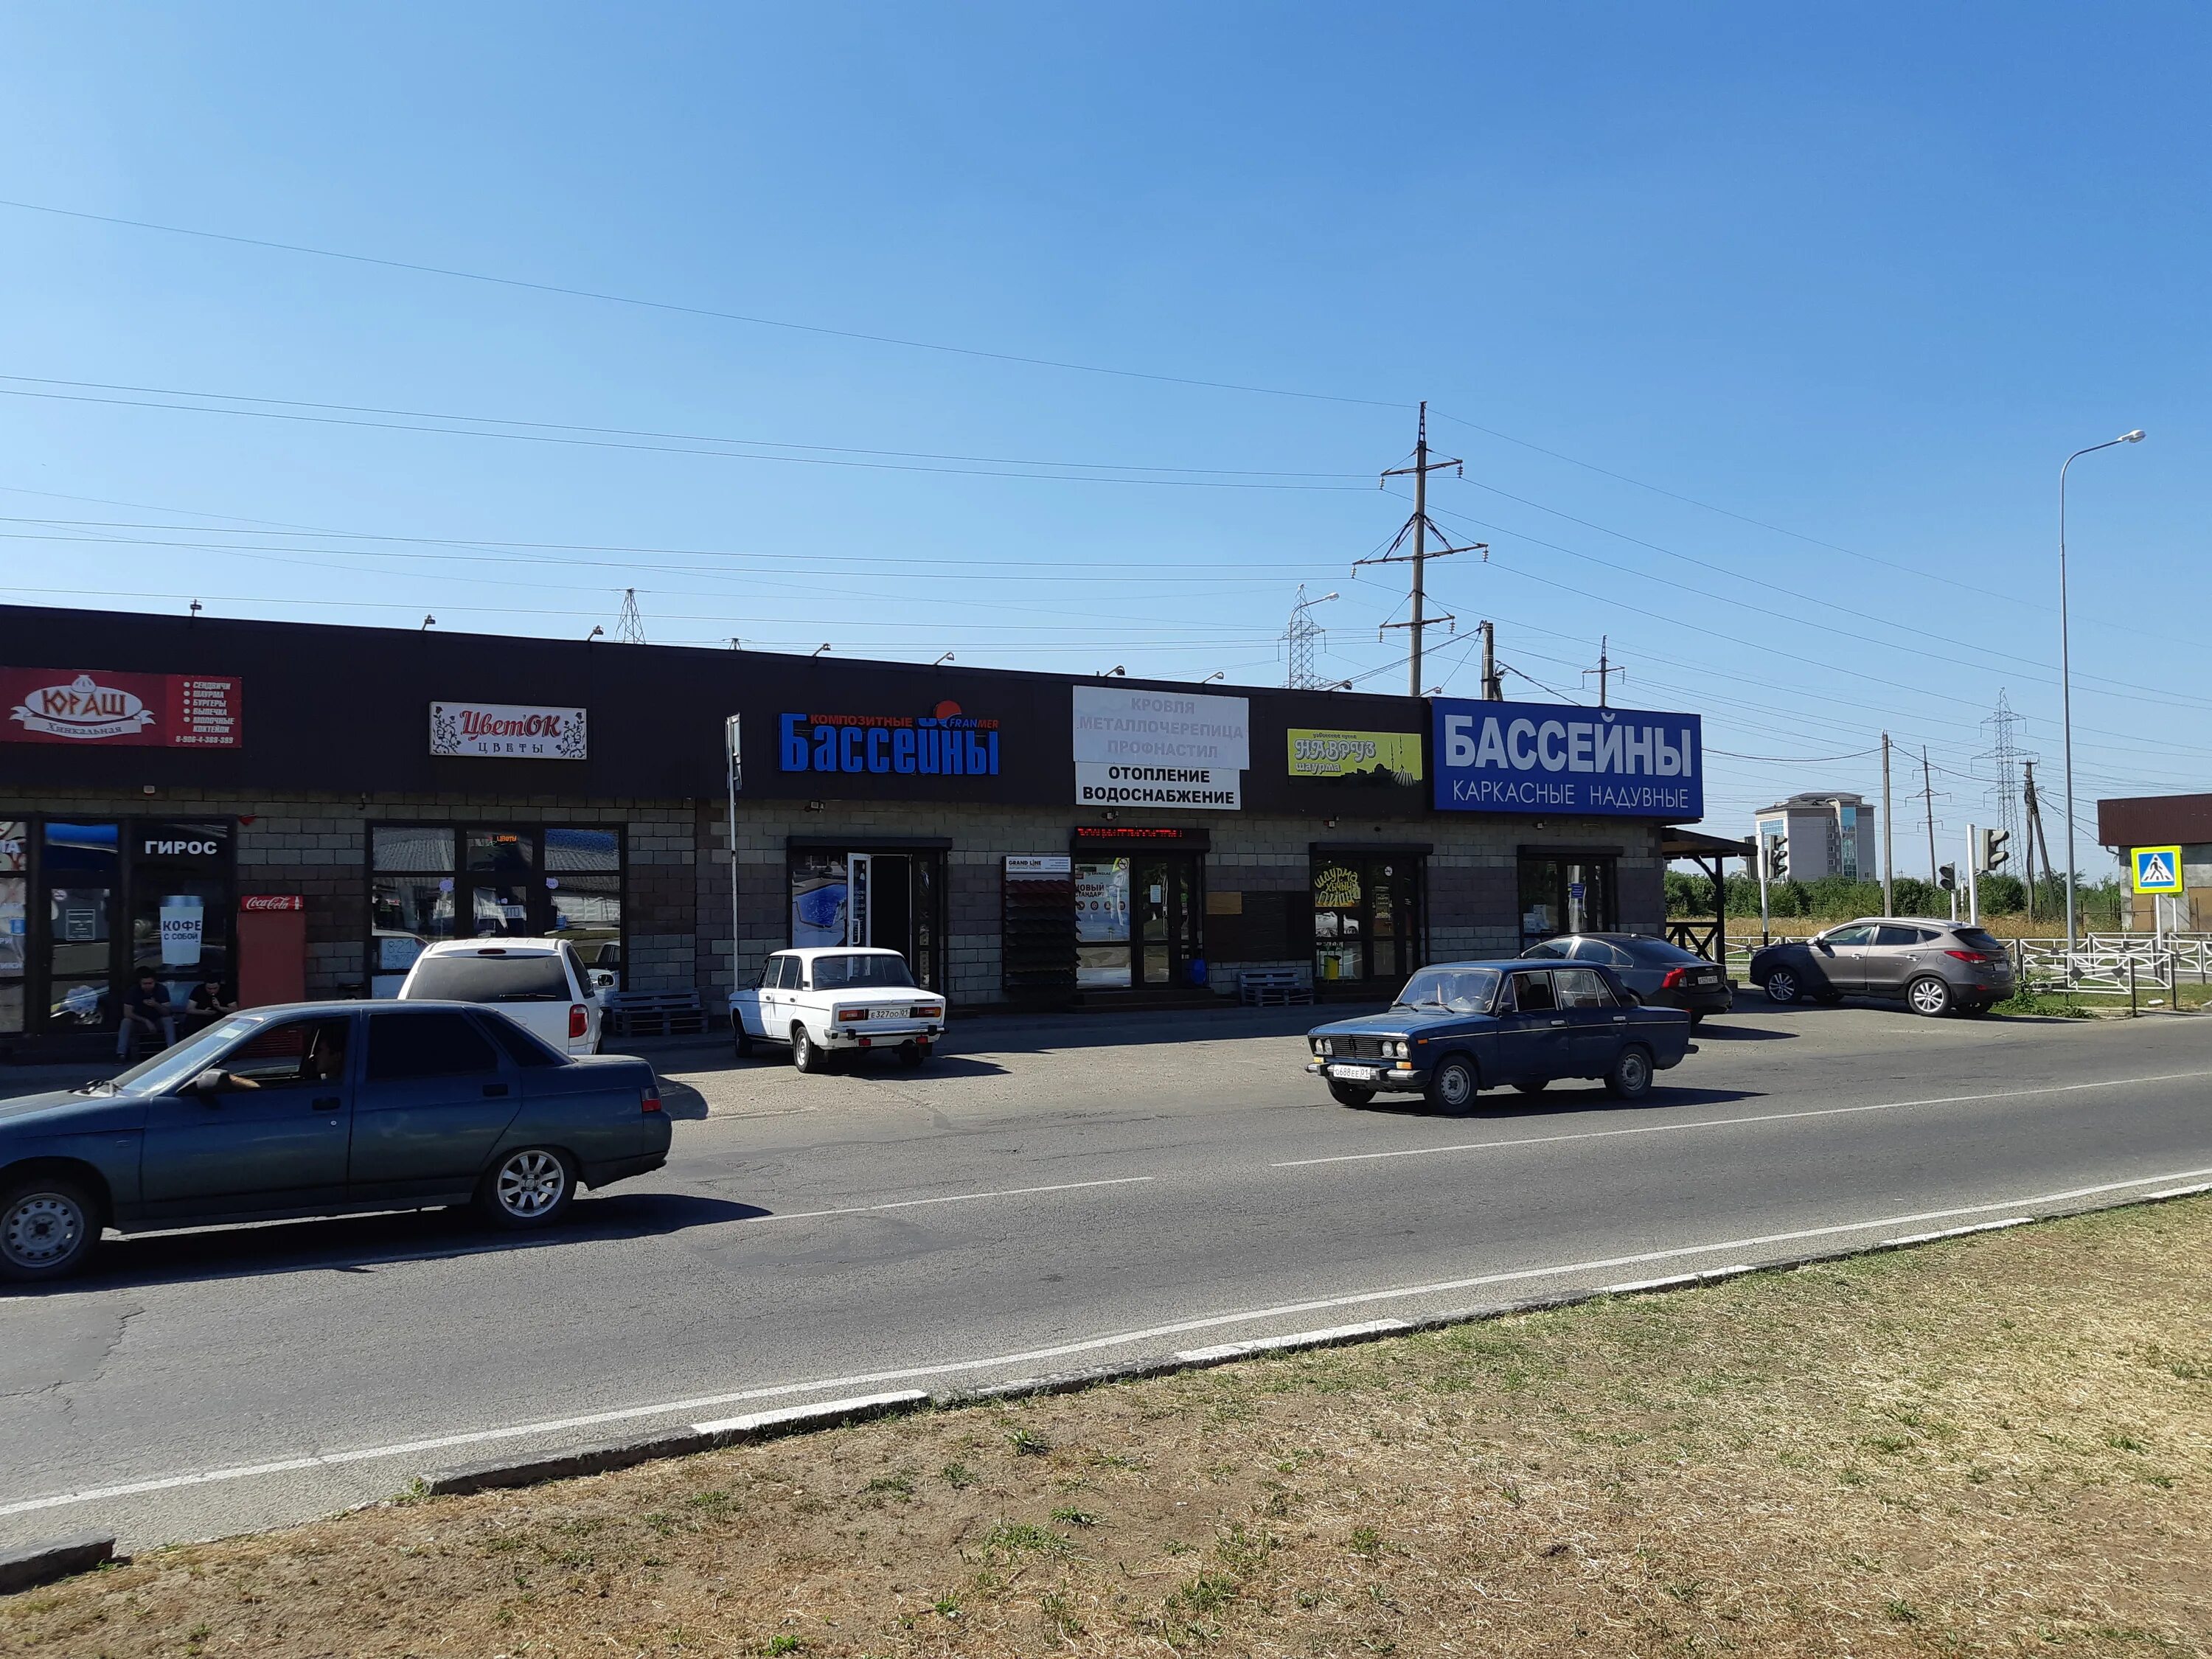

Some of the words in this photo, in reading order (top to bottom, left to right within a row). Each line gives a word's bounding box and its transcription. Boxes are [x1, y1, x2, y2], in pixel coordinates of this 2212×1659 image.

[192, 681, 231, 689] СЕНДВИЧИ
[192, 690, 224, 698] ШАУРМА
[41, 689, 126, 716] ЮРАШ
[192, 699, 227, 707] БУРГЕРЫ
[1130, 698, 1195, 714] КРОВЛЯ
[192, 708, 227, 716] ВЫПЕЧКА
[192, 717, 235, 725] МОЛОЧНЫЕ
[810, 714, 913, 727] КОМПОЗИТНЫЕ
[948, 718, 999, 728] FRANMER
[46, 722, 122, 735] Хинкальная
[192, 725, 230, 733] КОКТЕЙЛИ
[1079, 716, 1244, 740] МЕТАЛЛОЧЕРЕПИЦА
[479, 742, 543, 754] ЦВЕТЫ
[779, 713, 999, 775] Бассейны
[1107, 740, 1218, 758] ПРОФНАСТИЛ
[1444, 712, 1692, 777] БАССЕЙНЫ
[1295, 740, 1376, 763] НАВРУЗ
[1108, 766, 1211, 783] ОТОПЛЕНИЕ
[1295, 762, 1341, 774] шаурма
[1082, 786, 1235, 804] ВОДОСНАБЖЕНИЕ
[1453, 779, 1575, 804] КАРКАСНЫЕ
[1590, 785, 1688, 809] НАДУВНЫЕ
[144, 841, 218, 855] ГИРОС
[162, 920, 201, 931] КОФЕ
[172, 932, 198, 940] СОБОЙ
